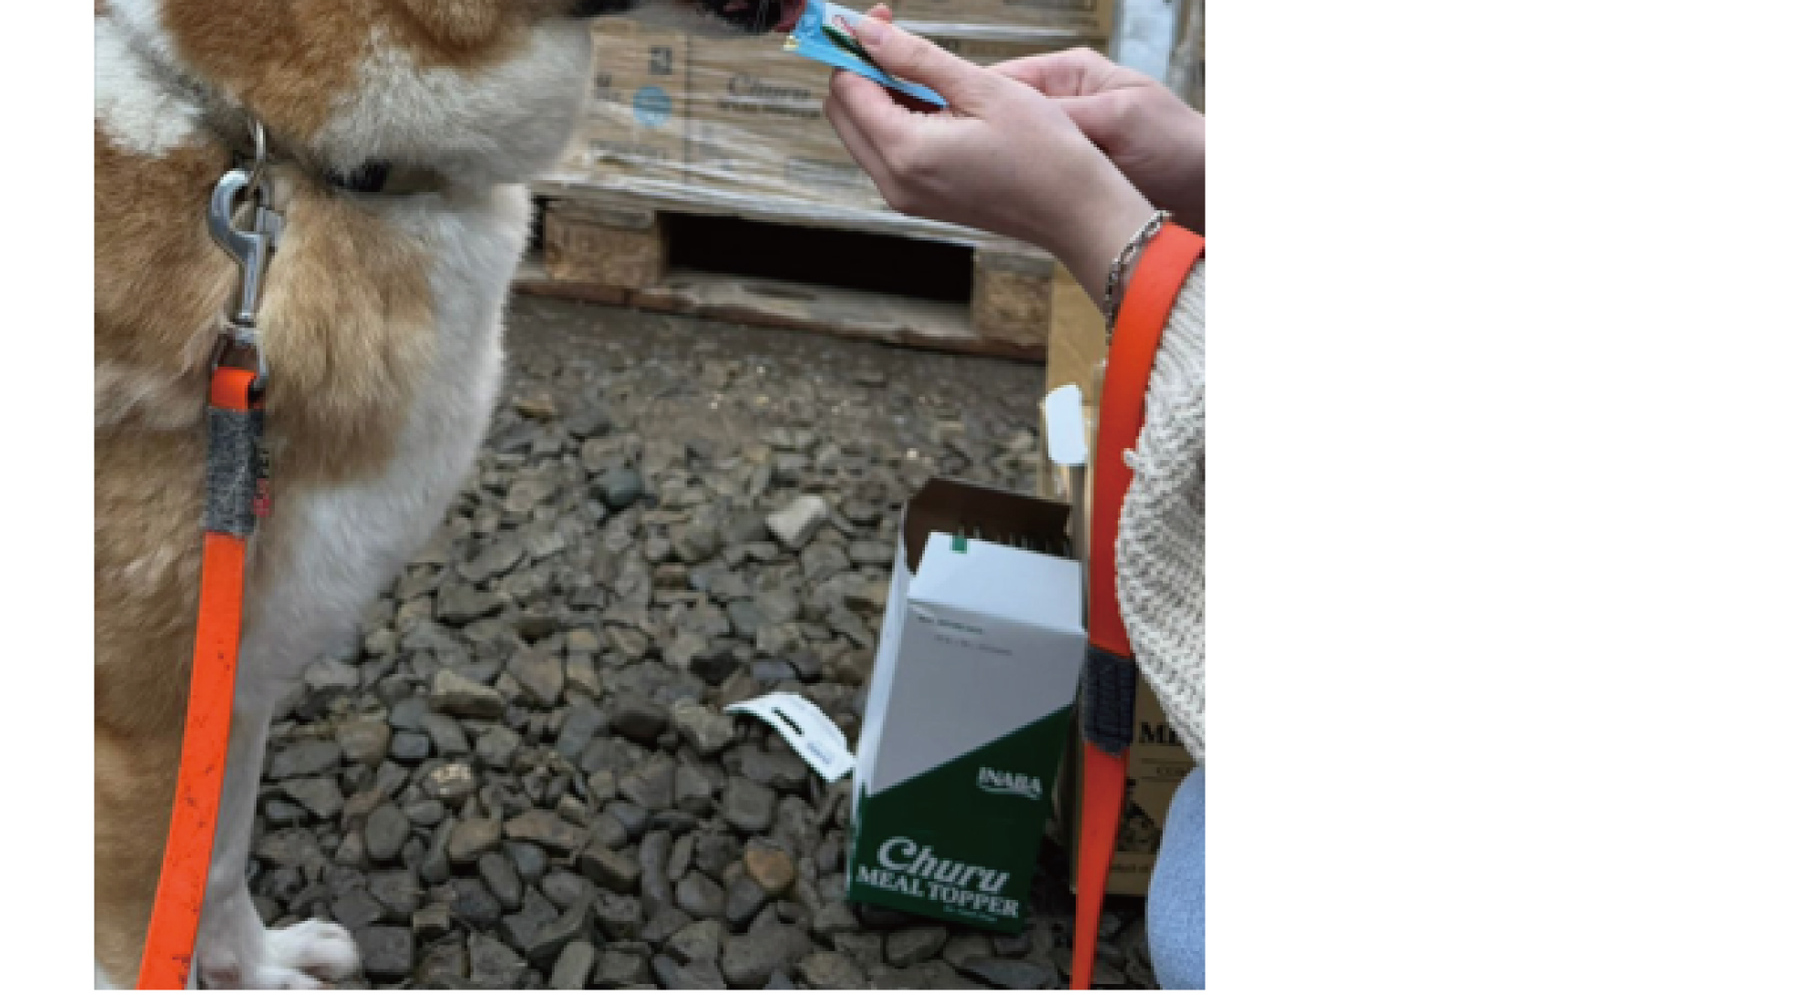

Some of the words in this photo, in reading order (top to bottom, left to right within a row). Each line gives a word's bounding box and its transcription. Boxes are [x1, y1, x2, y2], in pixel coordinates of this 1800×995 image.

[977, 767, 1043, 799] INABA
[856, 864, 925, 898] MEAL
[928, 881, 1020, 919] TOPPER
[876, 836, 1011, 893] Churu
